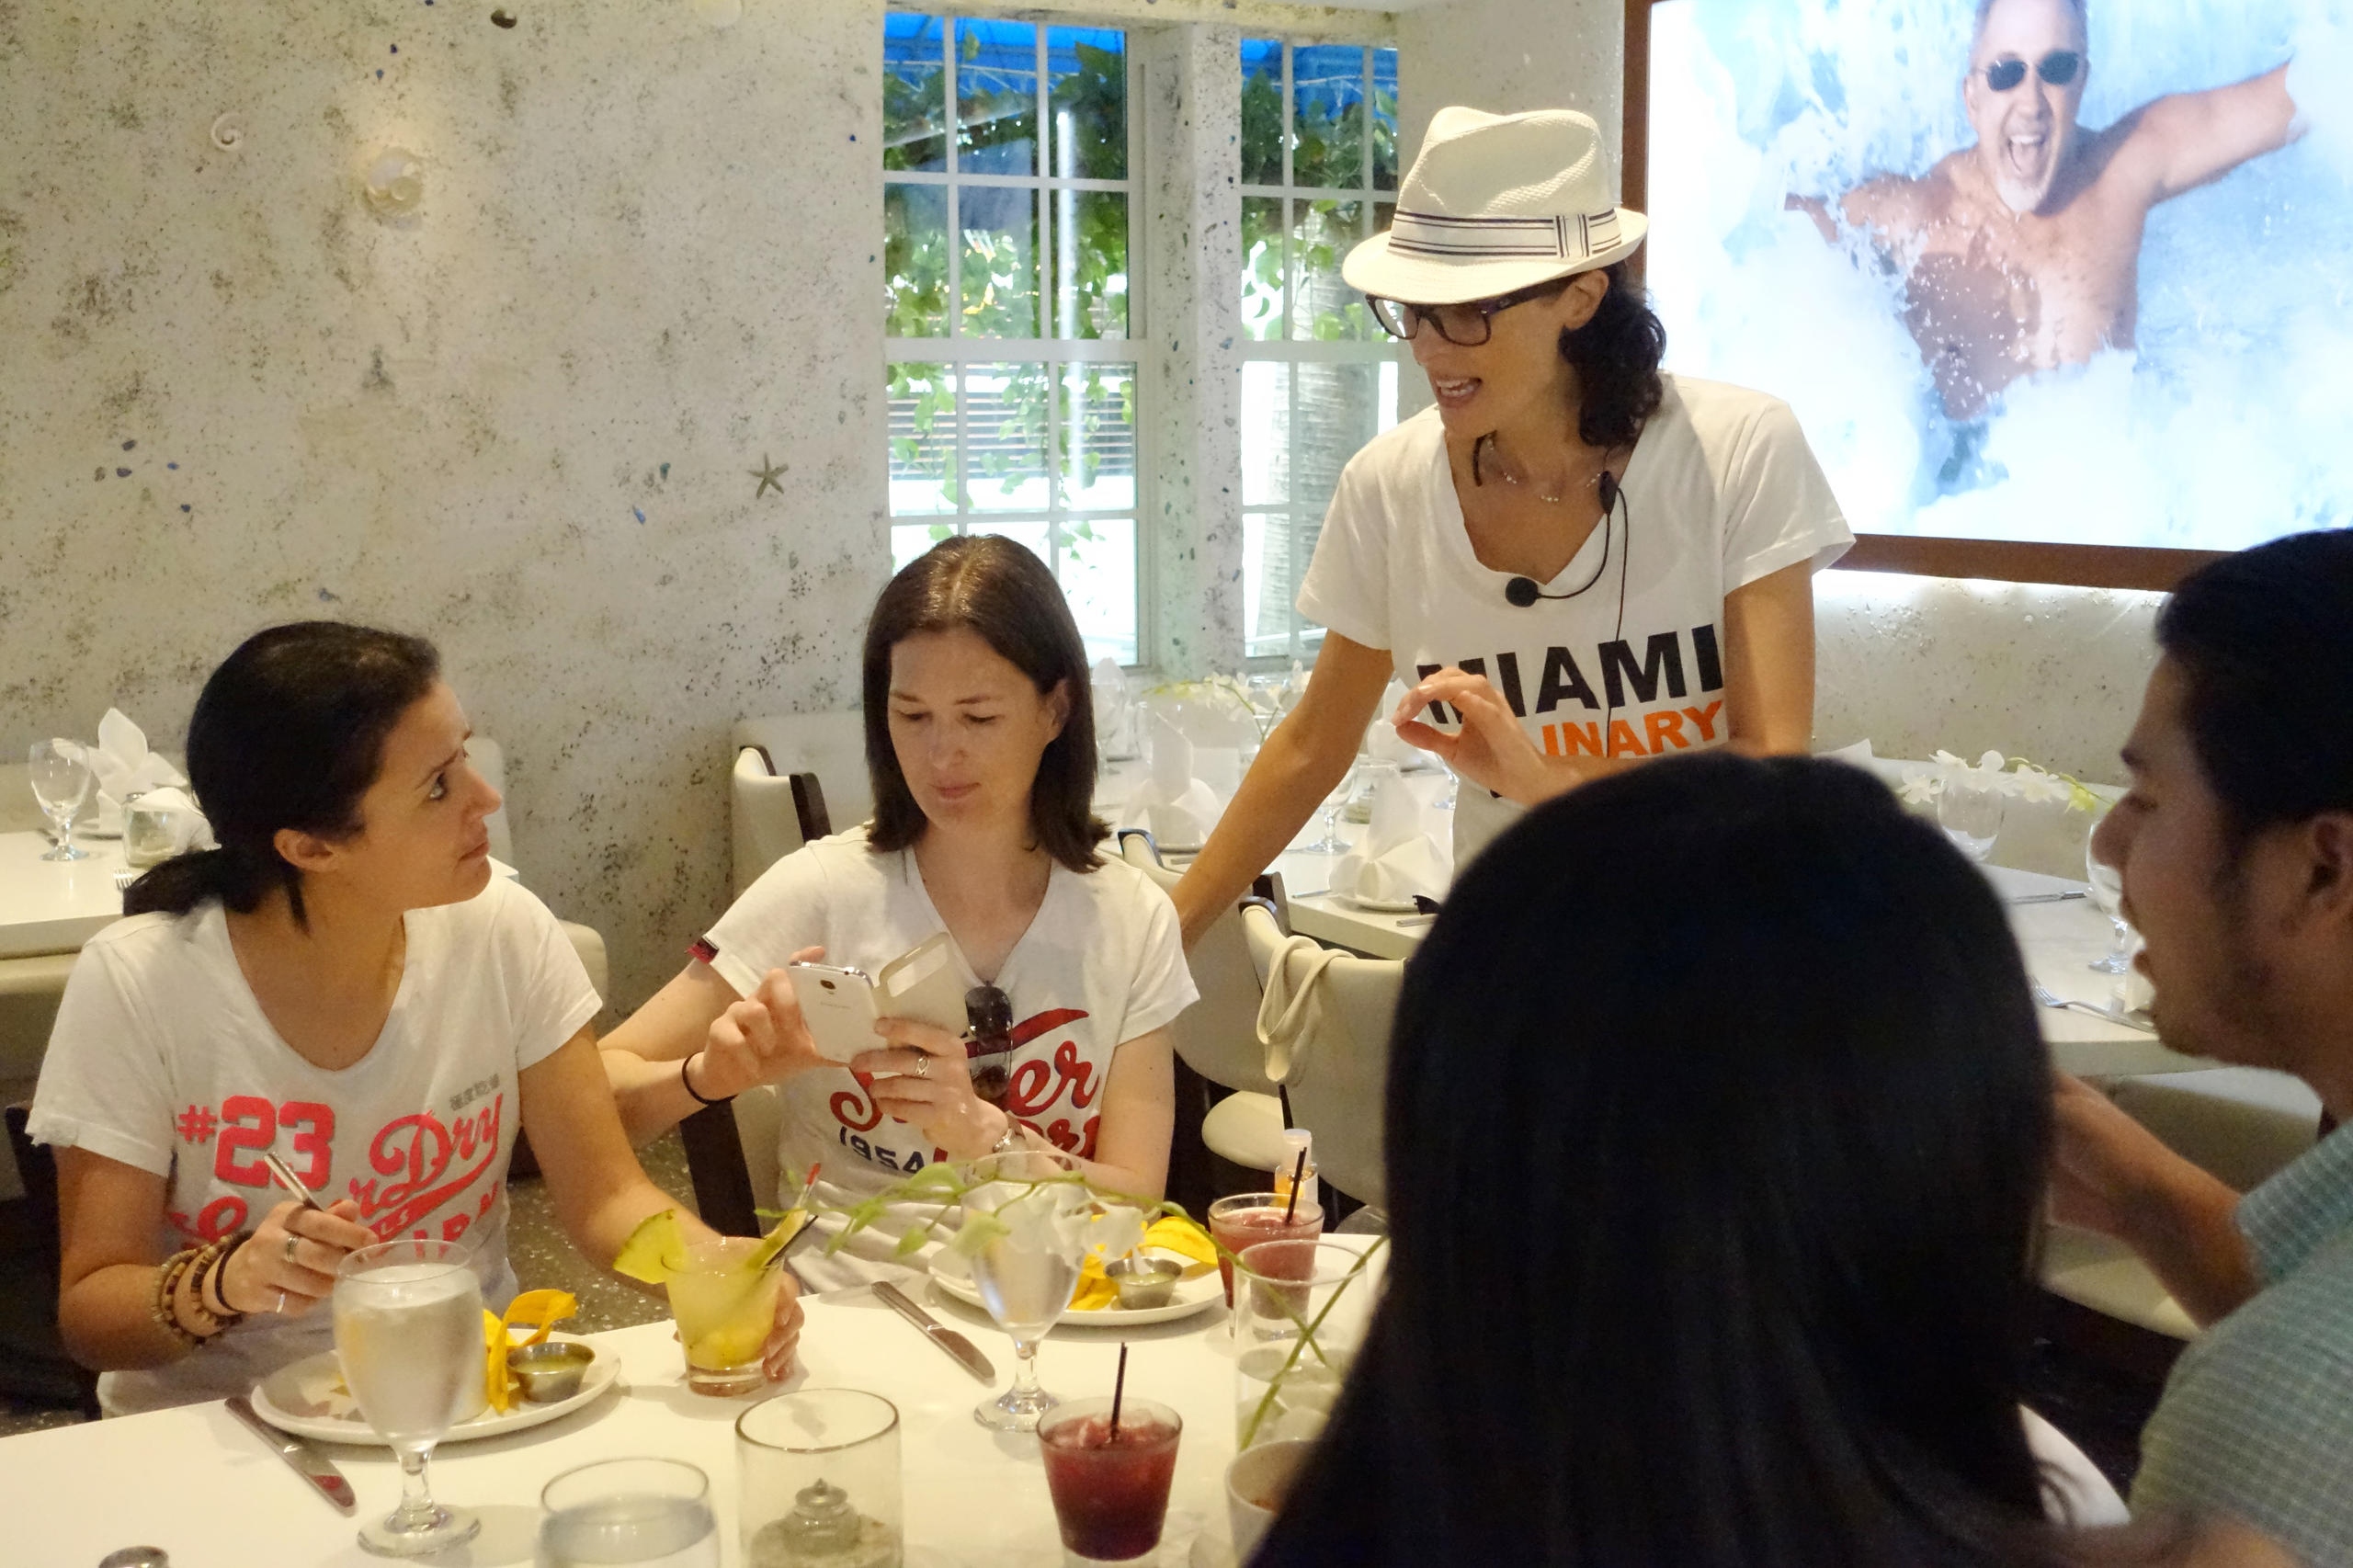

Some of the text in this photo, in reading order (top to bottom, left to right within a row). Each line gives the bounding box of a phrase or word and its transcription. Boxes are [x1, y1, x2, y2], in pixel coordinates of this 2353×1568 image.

[1416, 624, 1724, 724] IAMI
[1541, 700, 1723, 757] INARY
[177, 1095, 335, 1192] #23
[839, 1125, 925, 1174] 1954
